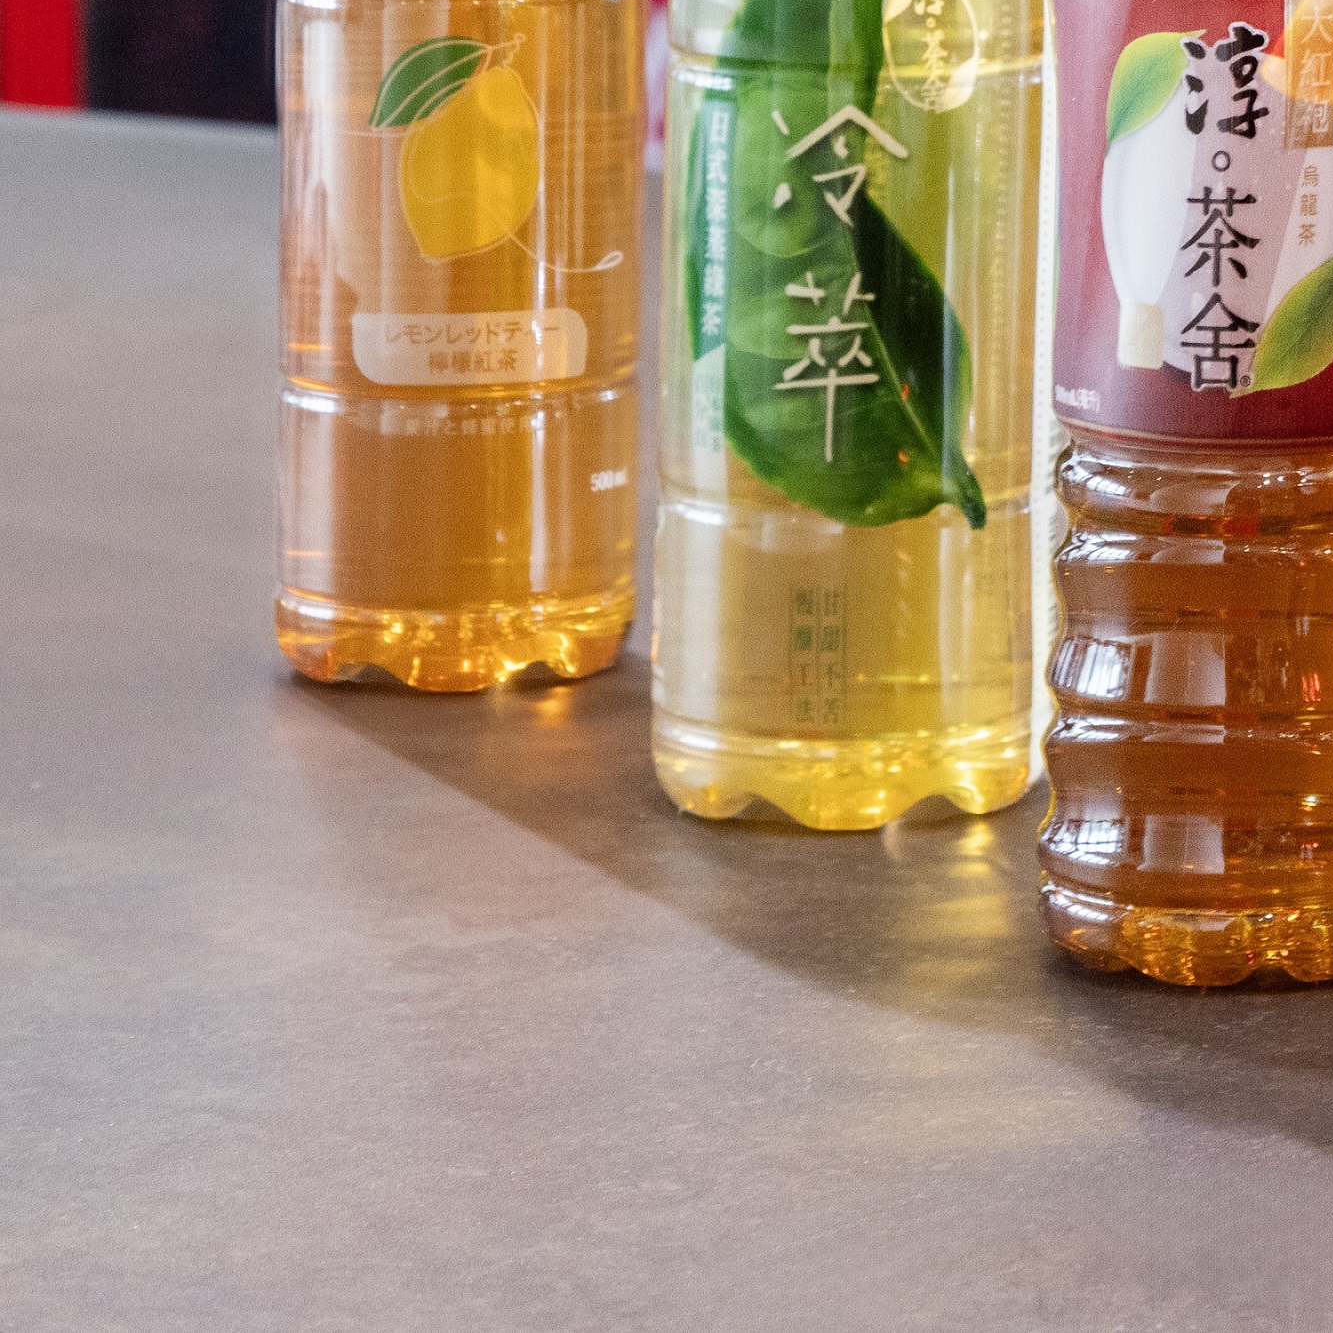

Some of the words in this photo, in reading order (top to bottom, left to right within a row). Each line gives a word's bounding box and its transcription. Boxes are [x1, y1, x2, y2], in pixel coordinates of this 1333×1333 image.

[1298, 4, 1333, 134] 大紅袍
[1299, 165, 1319, 246] 烏龍茶
[386, 320, 560, 345] レモンレッドテー
[771, 104, 910, 463] 冷萃
